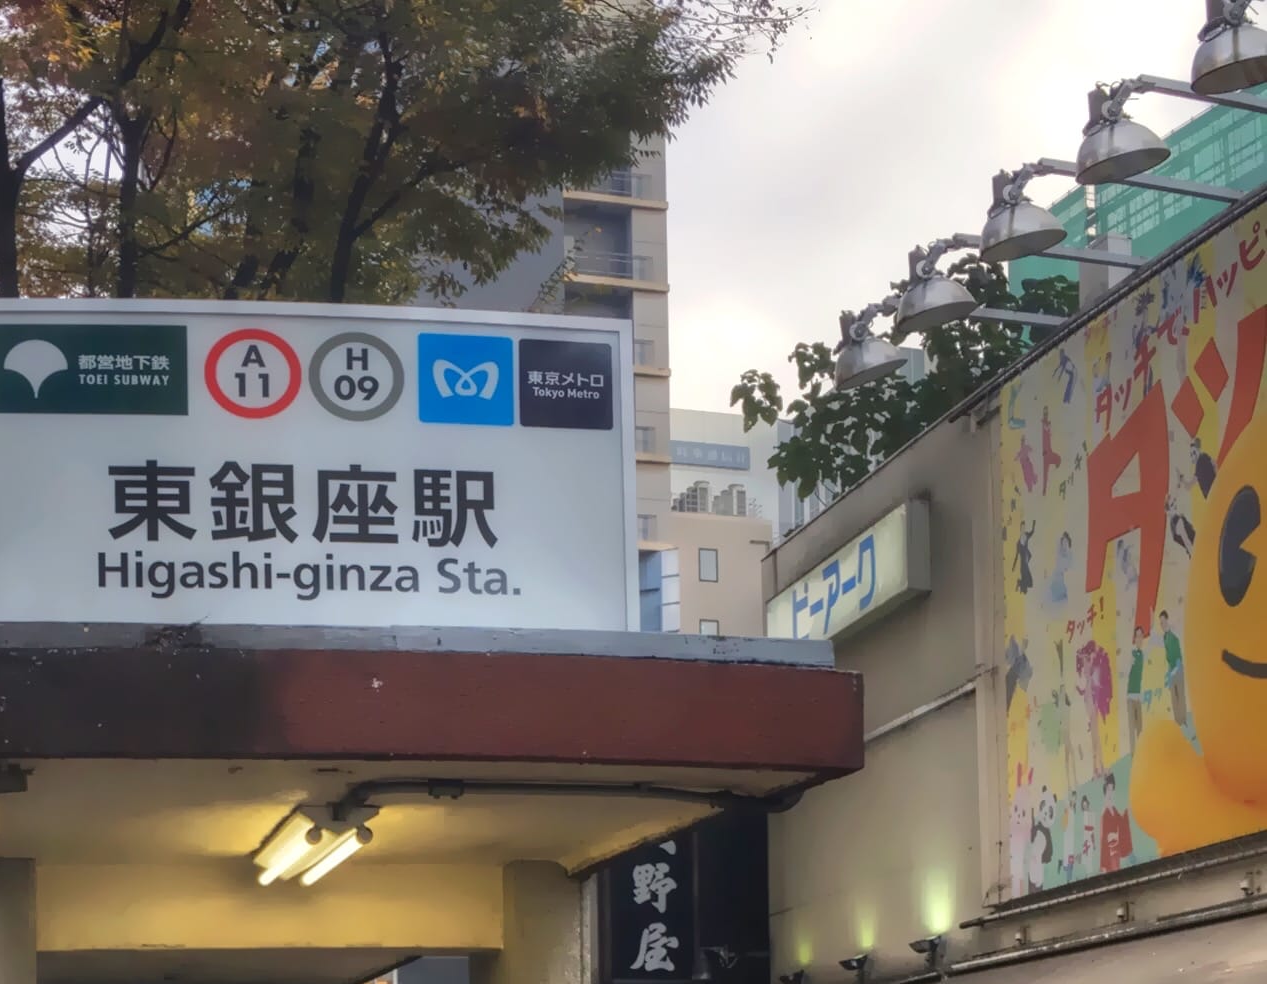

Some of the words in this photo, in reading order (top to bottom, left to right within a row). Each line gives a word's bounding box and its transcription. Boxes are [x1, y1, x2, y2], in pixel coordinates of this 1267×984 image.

[78, 355, 170, 370] 都営地下鉄
[241, 345, 266, 367] A
[346, 347, 369, 371] H
[78, 374, 108, 385] TOEI
[114, 375, 170, 386] SUBWAY
[235, 372, 269, 398] 11
[334, 375, 379, 400] 09
[527, 370, 604, 387] 東京メトロ
[532, 386, 565, 399] Tokyo
[567, 388, 600, 399] Metro
[107, 460, 499, 549] 東銀座駅
[97, 551, 420, 601] Higashi-ginza
[437, 557, 522, 597] Sta.
[630, 840, 679, 972] 野屋
